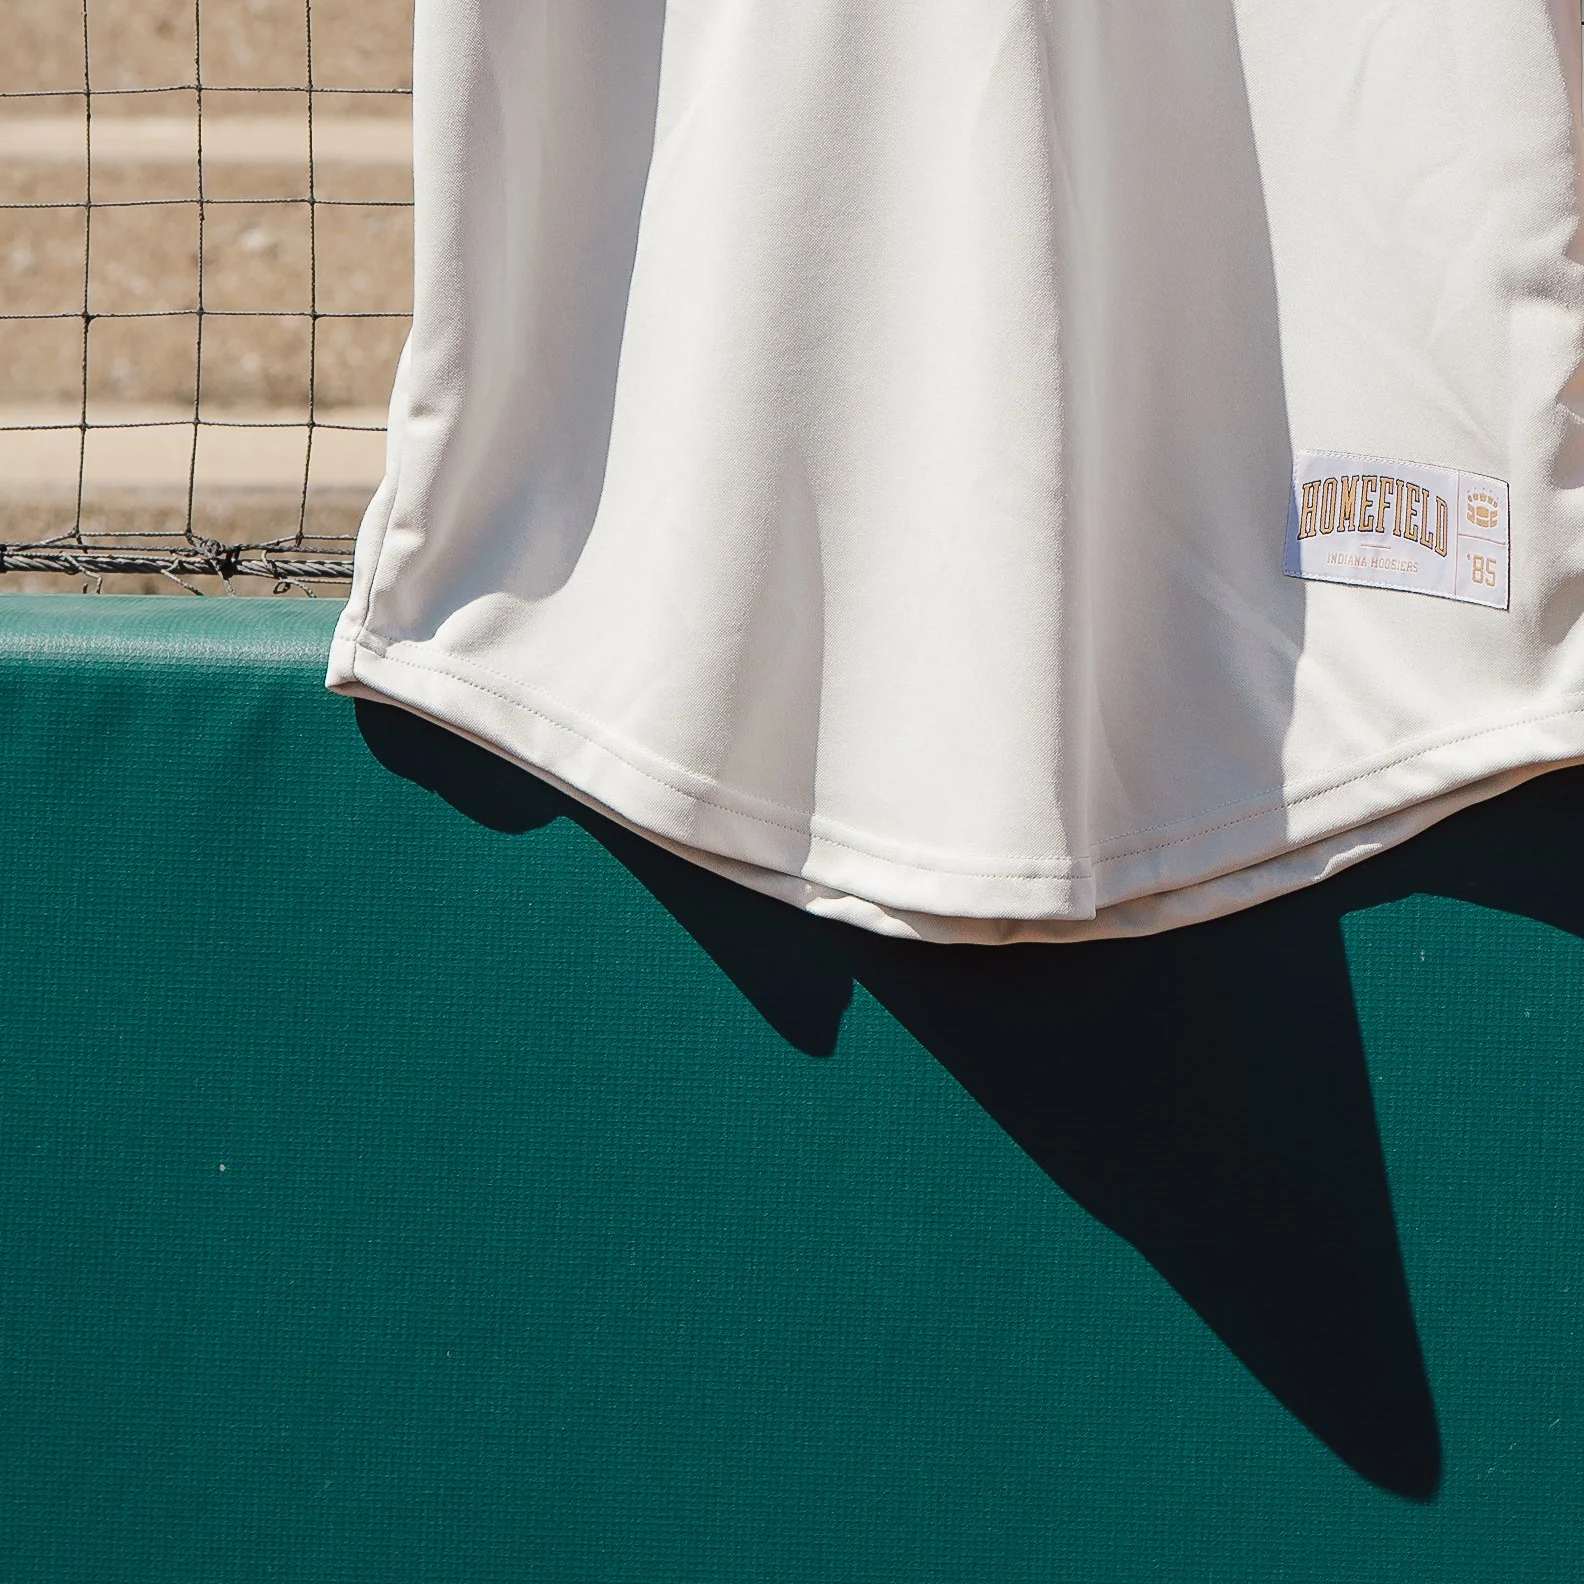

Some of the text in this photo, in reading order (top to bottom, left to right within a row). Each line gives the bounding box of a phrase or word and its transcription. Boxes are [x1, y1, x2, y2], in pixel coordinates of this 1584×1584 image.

[1297, 474, 1449, 558] HOMEFIELD
[1327, 552, 1419, 574] INDIANA HOOSIERS
[1467, 552, 1497, 587] '85
